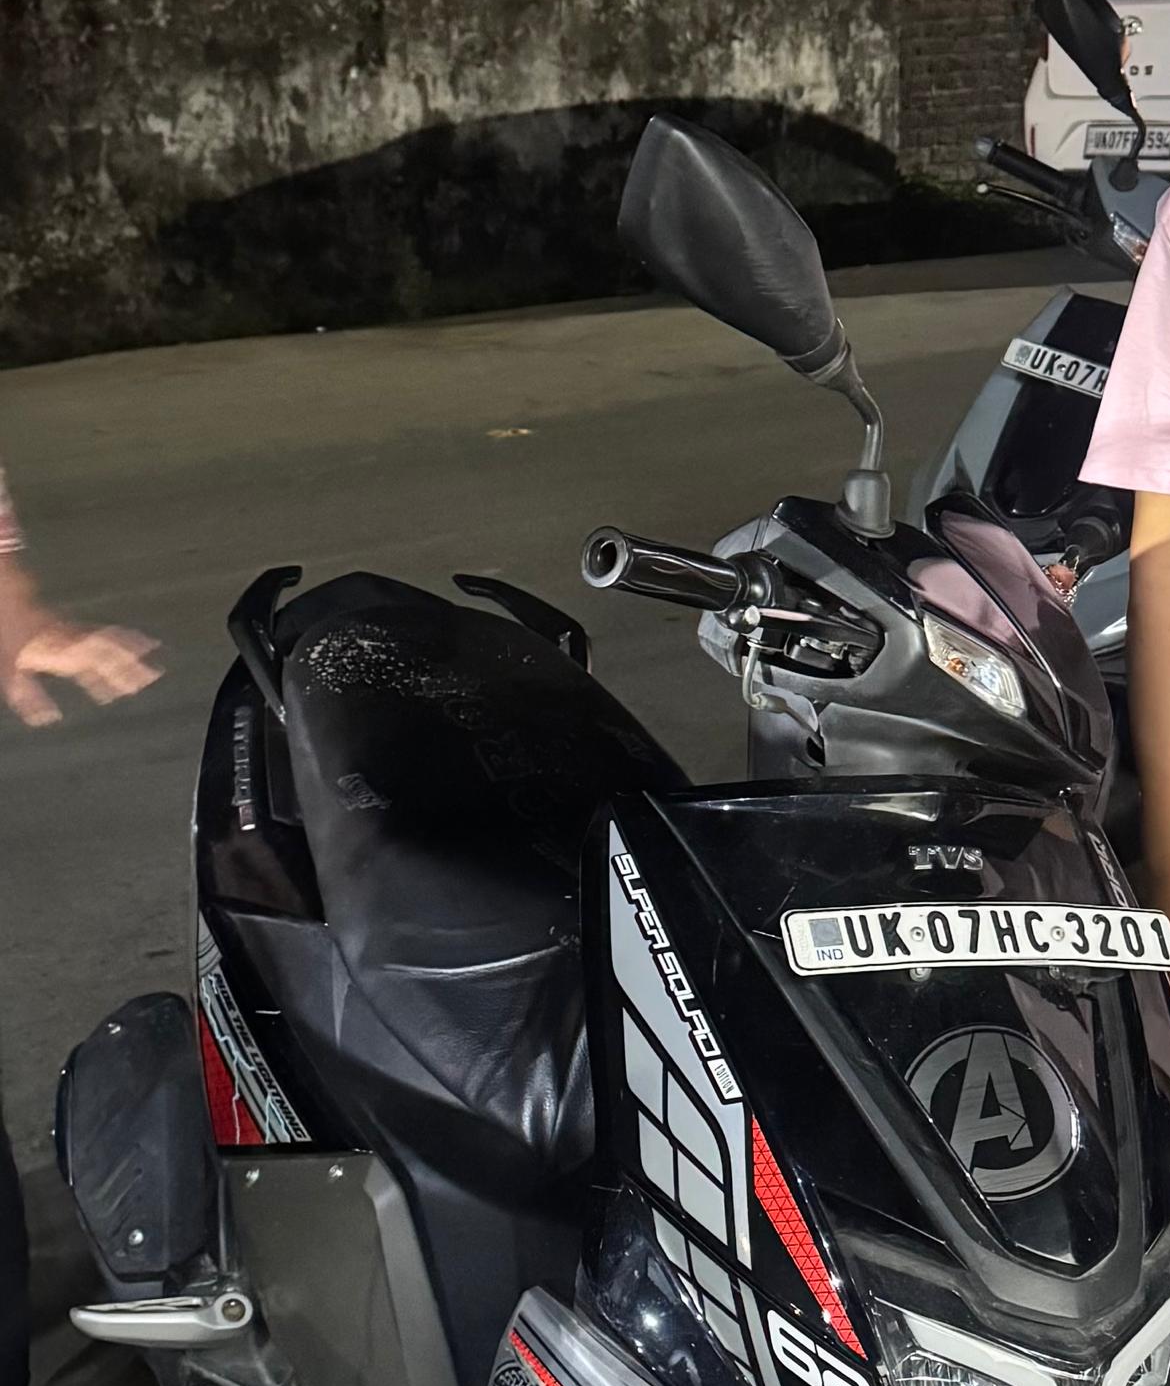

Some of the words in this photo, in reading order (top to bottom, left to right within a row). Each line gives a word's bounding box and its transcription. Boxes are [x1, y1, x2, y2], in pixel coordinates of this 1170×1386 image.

[908, 845, 984, 871] TVS
[614, 853, 671, 950] SUPER
[656, 951, 722, 1058] SQUAD
[815, 947, 844, 961] IND
[232, 1014, 255, 1049] THE
[251, 1051, 307, 1141] LIGHTNING
[713, 1063, 736, 1095] EDITION
